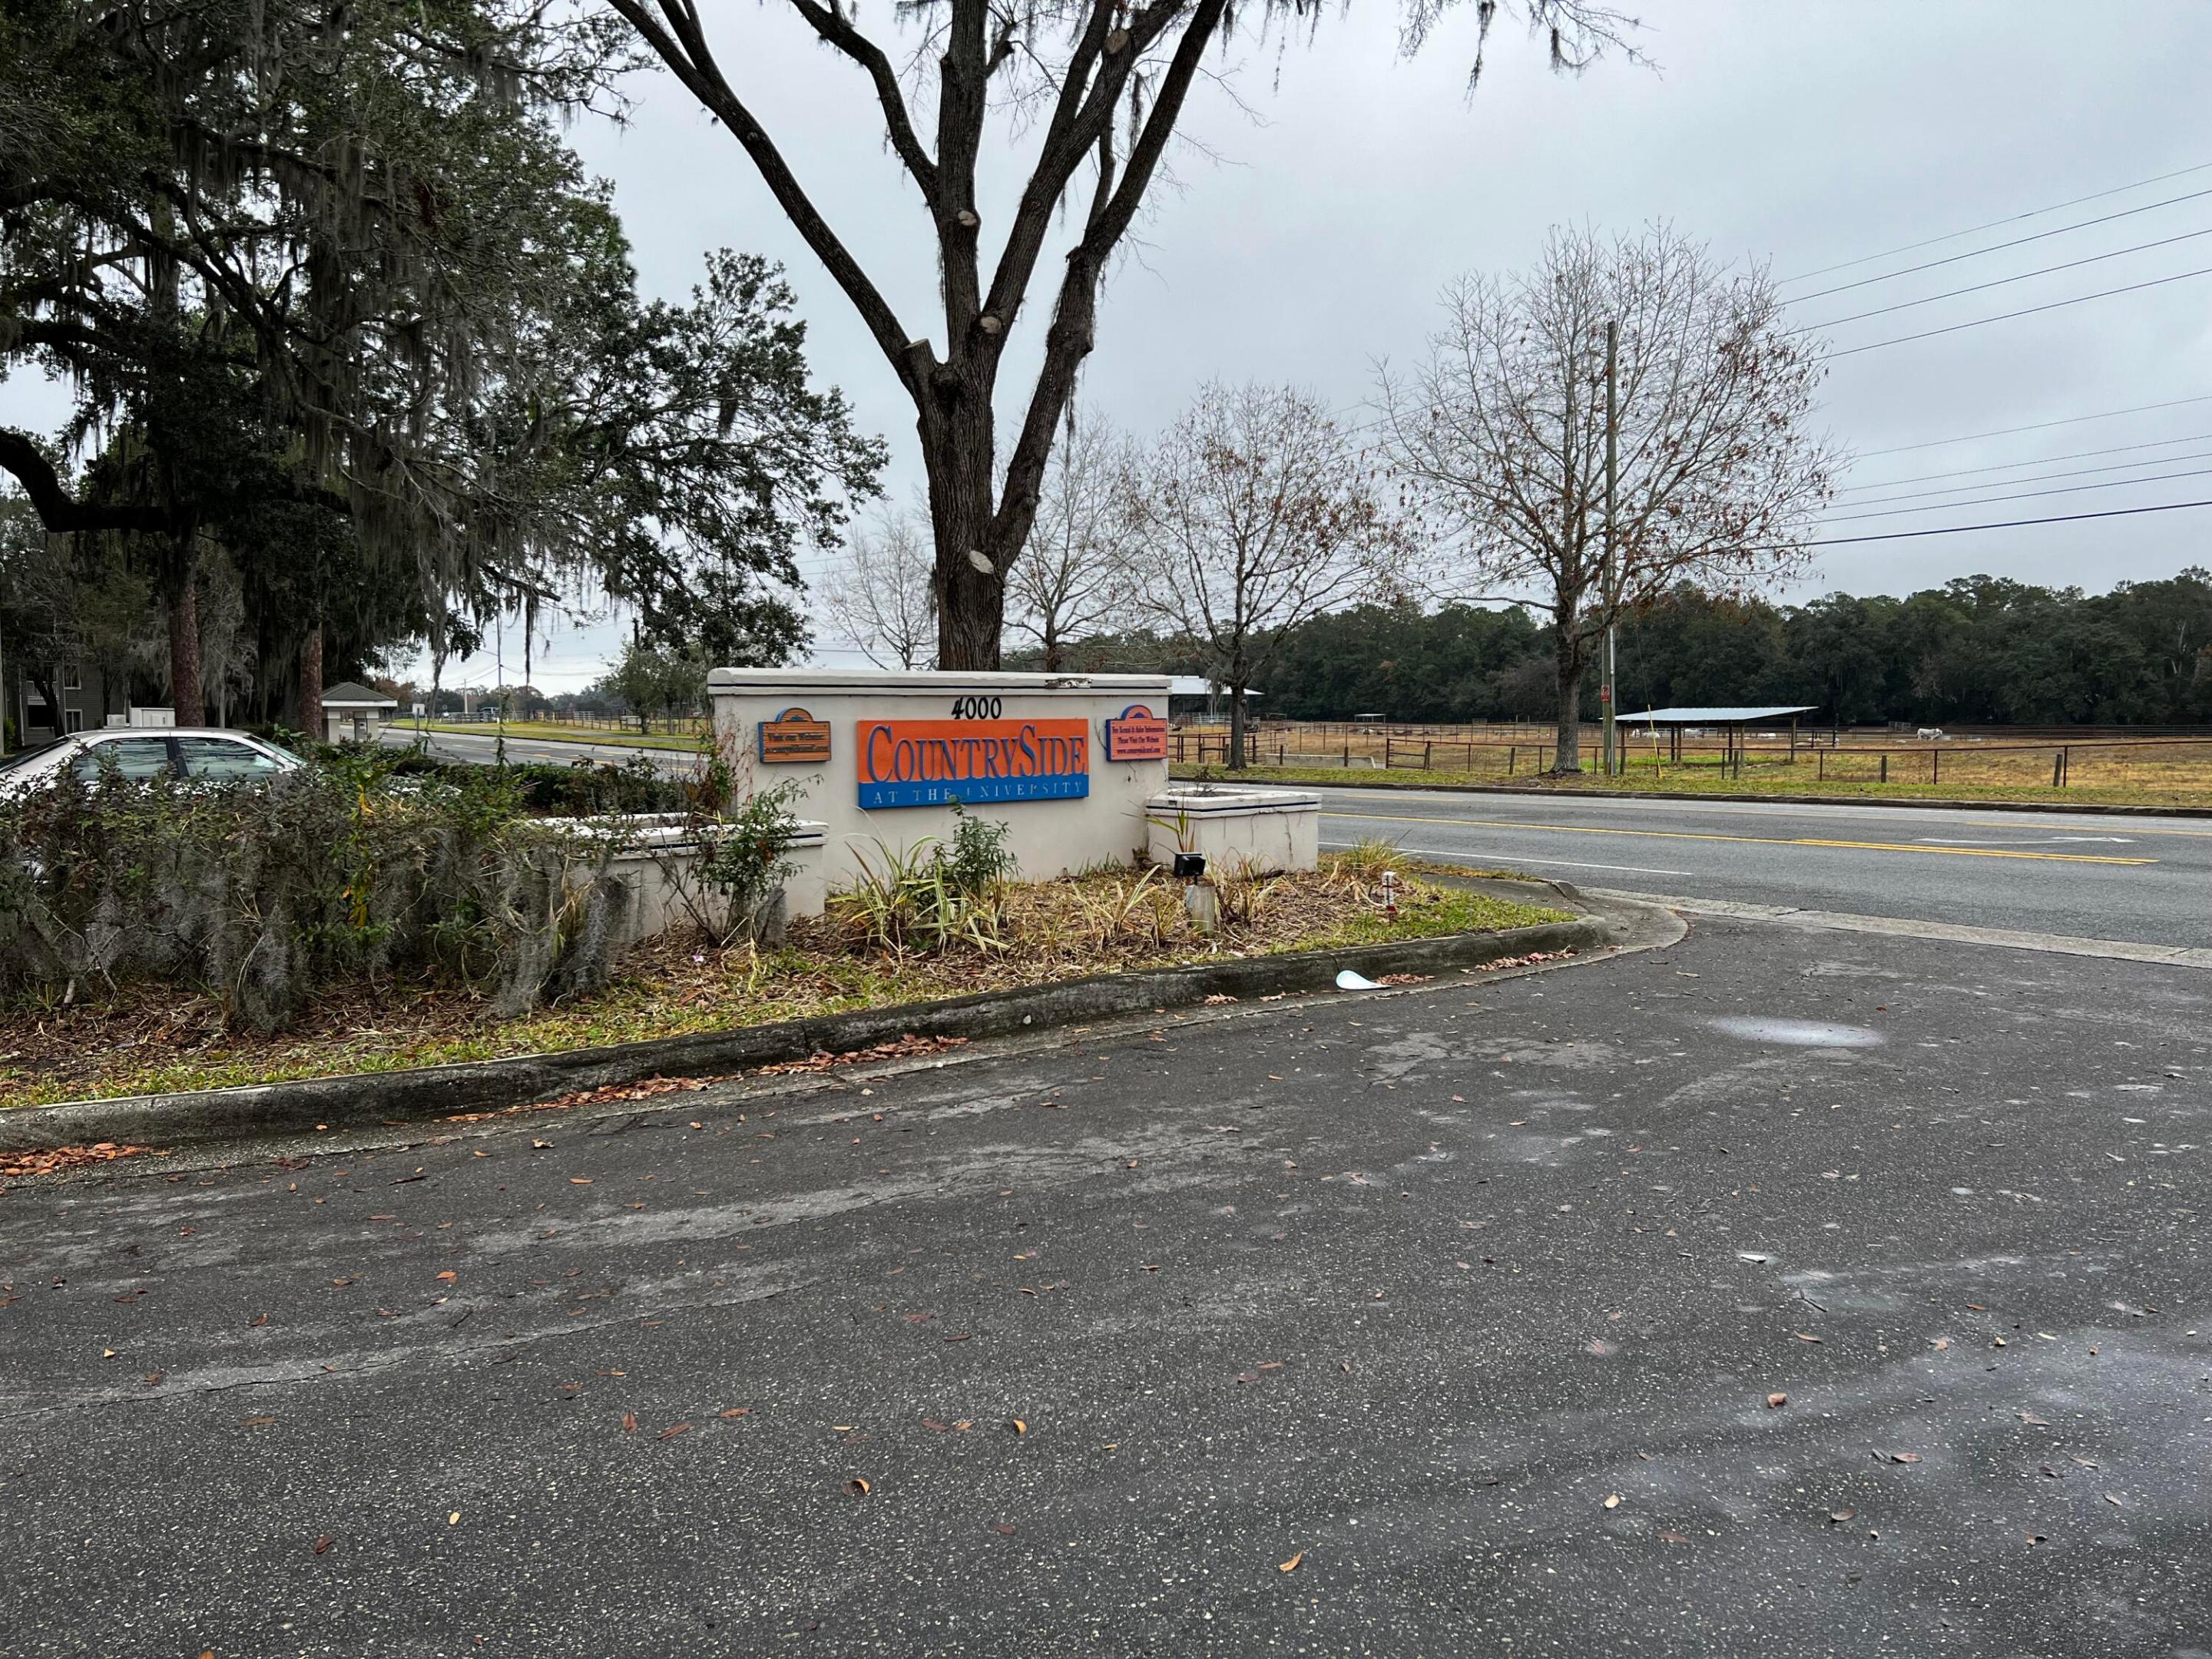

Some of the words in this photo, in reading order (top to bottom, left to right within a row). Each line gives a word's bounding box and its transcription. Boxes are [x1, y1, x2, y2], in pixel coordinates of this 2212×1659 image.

[951, 697, 1002, 720] 4000
[873, 790, 898, 803] AT
[912, 788, 952, 801] THE
